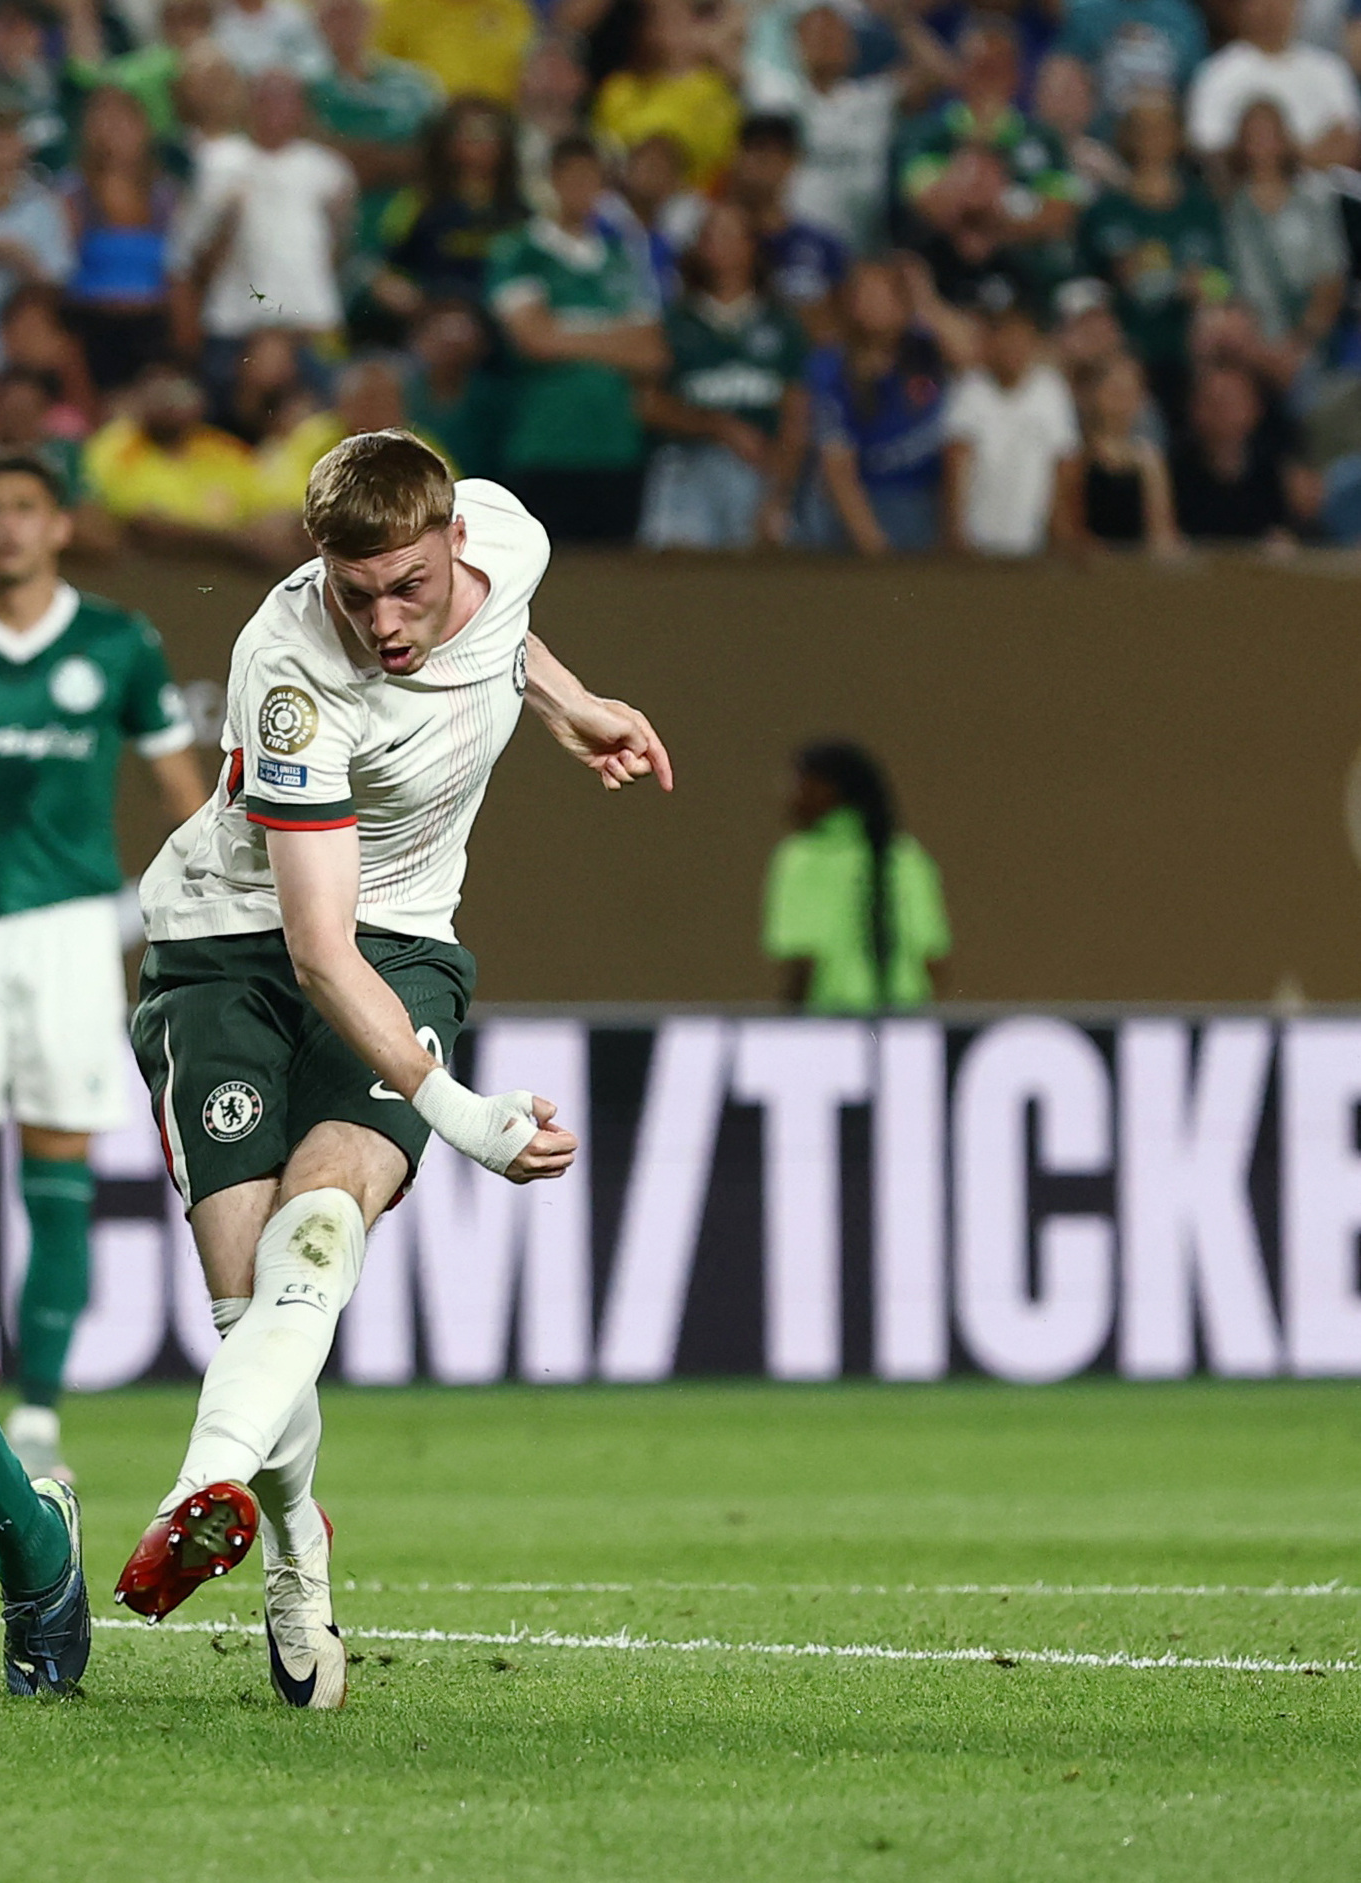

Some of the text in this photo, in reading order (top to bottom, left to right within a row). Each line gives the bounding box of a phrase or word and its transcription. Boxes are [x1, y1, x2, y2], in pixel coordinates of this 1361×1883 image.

[266, 691, 295, 708] WORLD
[294, 696, 311, 714] CUP
[260, 708, 269, 733] CLUB
[265, 735, 290, 752] FIFA
[293, 727, 311, 745] USA
[210, 1084, 247, 1104] CHELSEA
[283, 1283, 327, 1308] CFC
